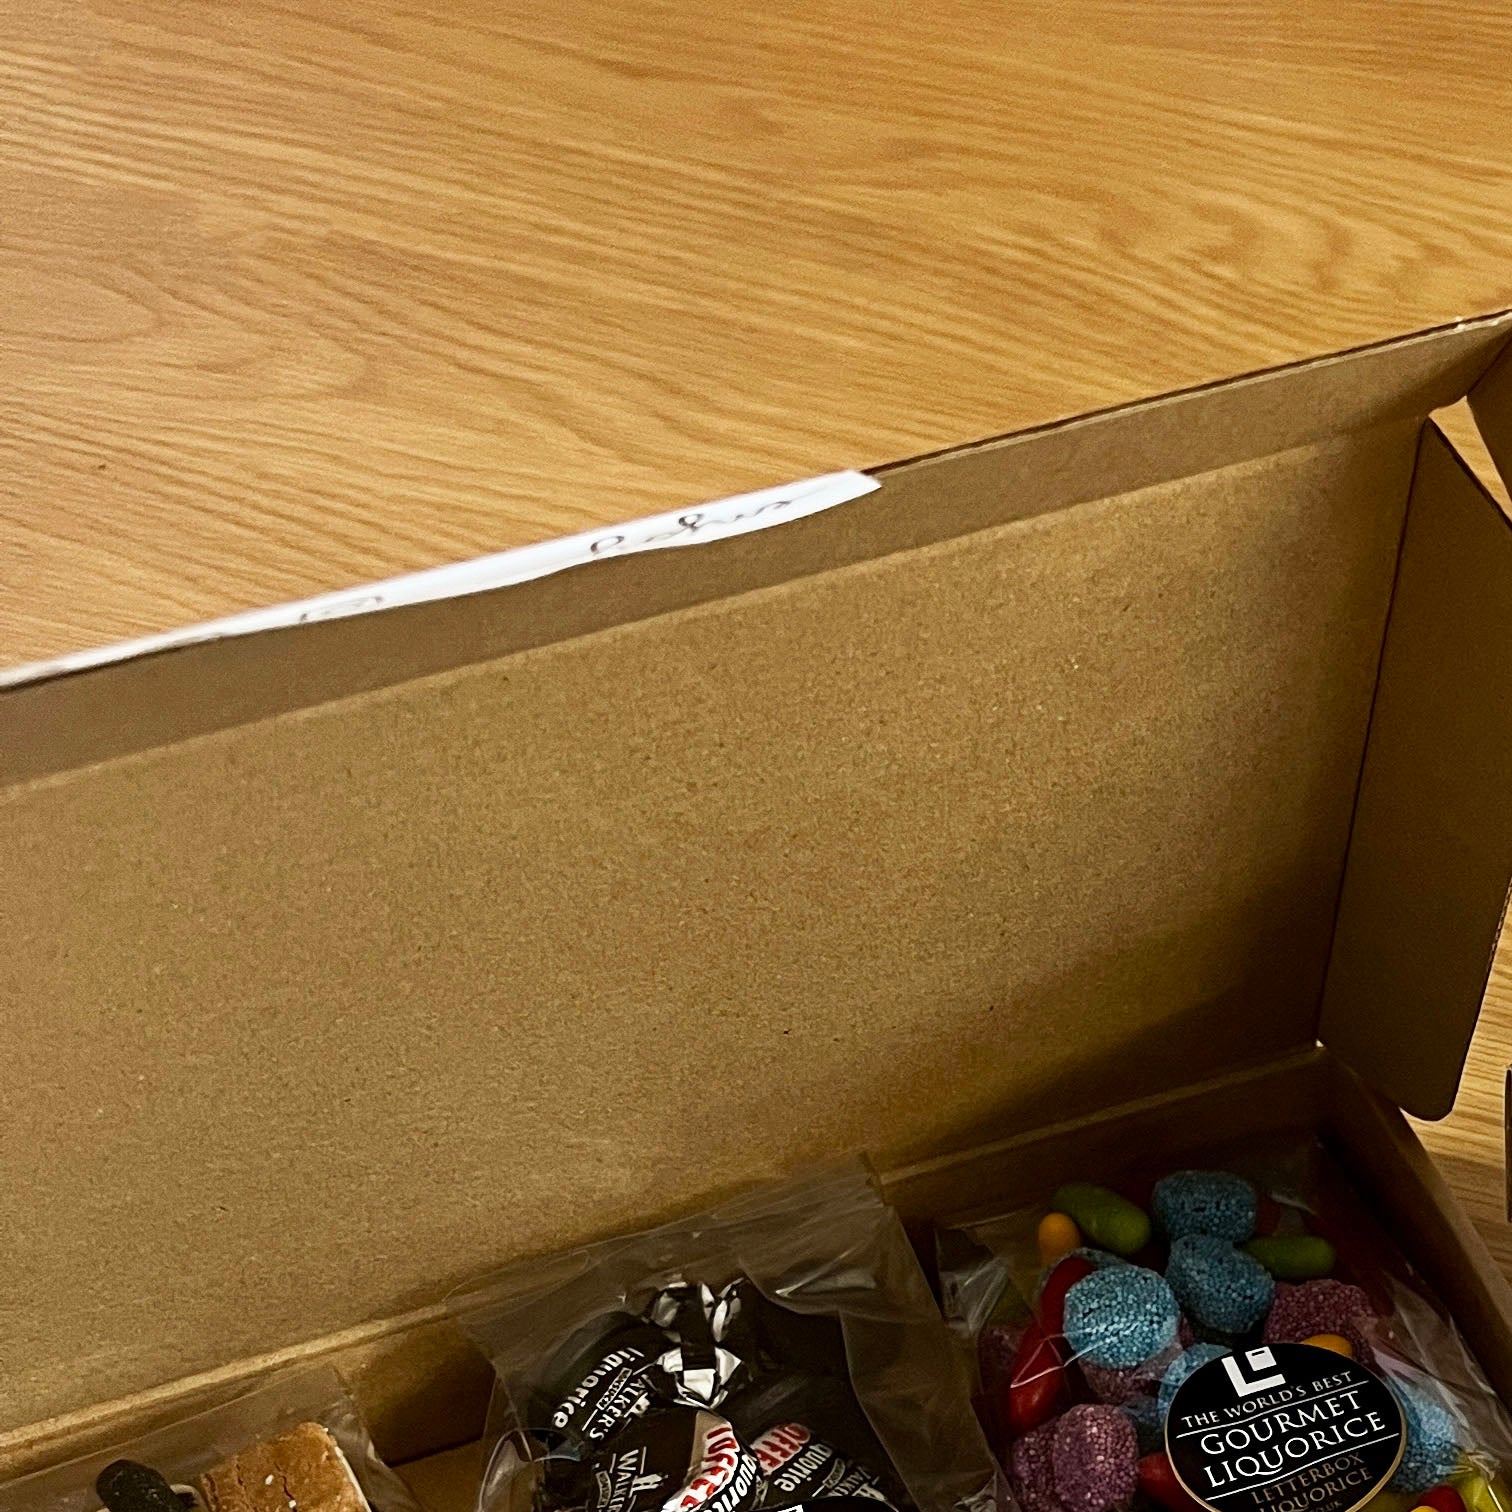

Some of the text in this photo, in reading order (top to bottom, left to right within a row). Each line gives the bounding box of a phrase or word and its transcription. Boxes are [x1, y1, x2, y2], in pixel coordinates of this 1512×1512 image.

[1181, 1371, 1353, 1429] THE WORLD'S BEST
[1200, 1390, 1364, 1455] GOURMET
[1203, 1411, 1387, 1488] LIQUORICE
[1251, 1452, 1366, 1505] LETTERBOX
